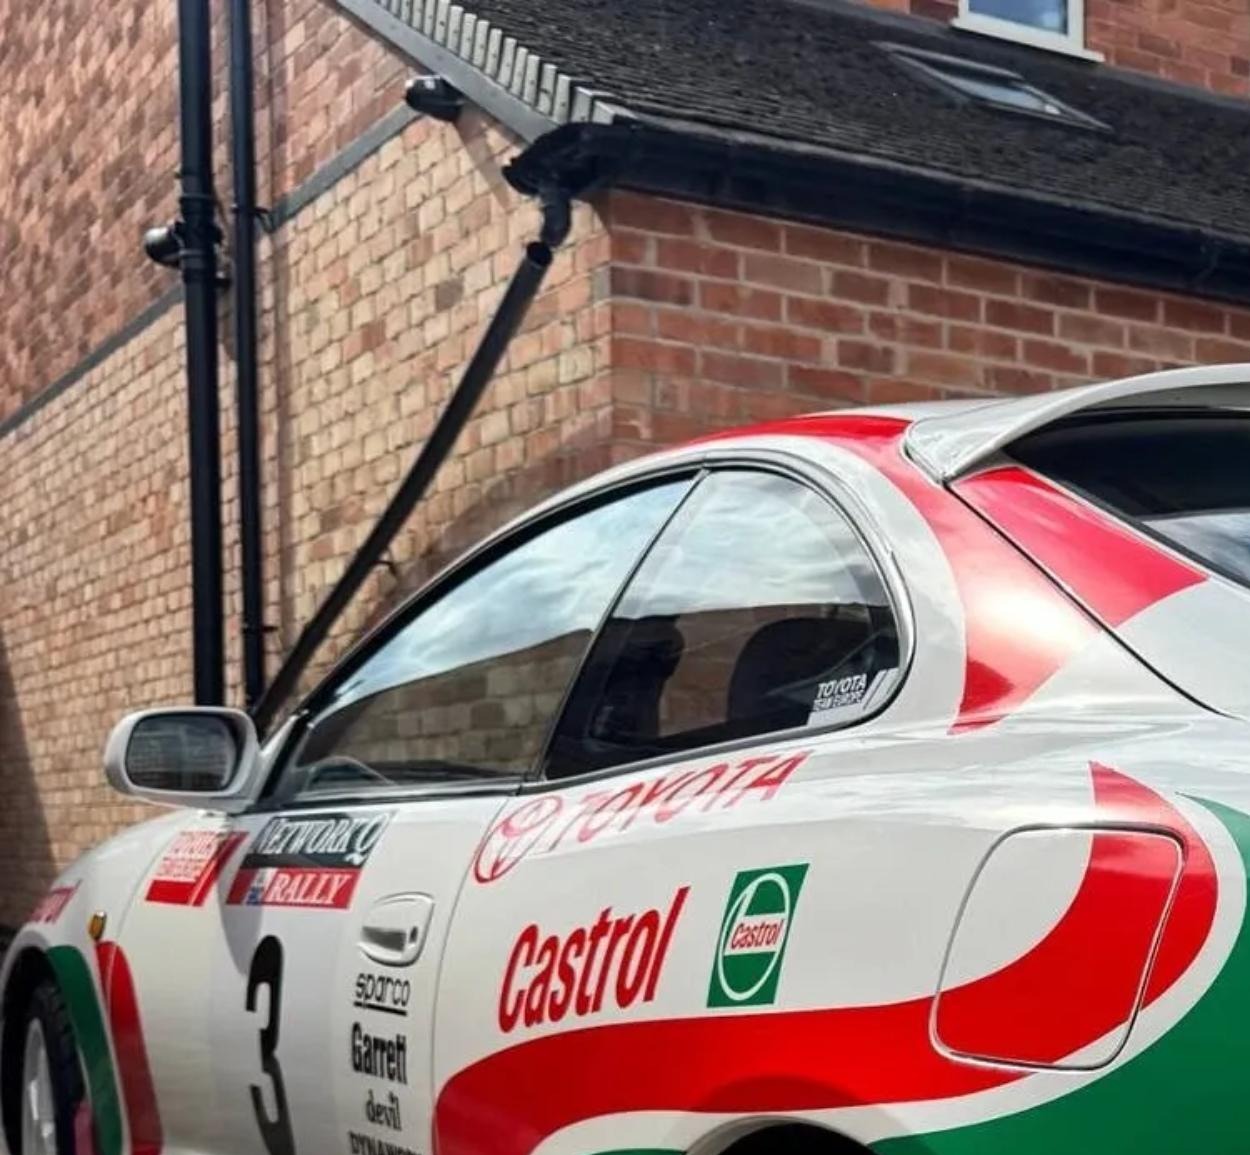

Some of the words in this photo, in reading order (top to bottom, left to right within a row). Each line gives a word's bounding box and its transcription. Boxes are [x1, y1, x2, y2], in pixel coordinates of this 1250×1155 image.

[817, 673, 867, 698] TOYOTA
[547, 750, 815, 851] TOYOTA
[265, 872, 351, 905] RALLY
[730, 918, 784, 950] Castrol
[498, 886, 691, 1034] Castrol
[355, 973, 411, 1008] sparco
[352, 1021, 408, 1085] Garrett
